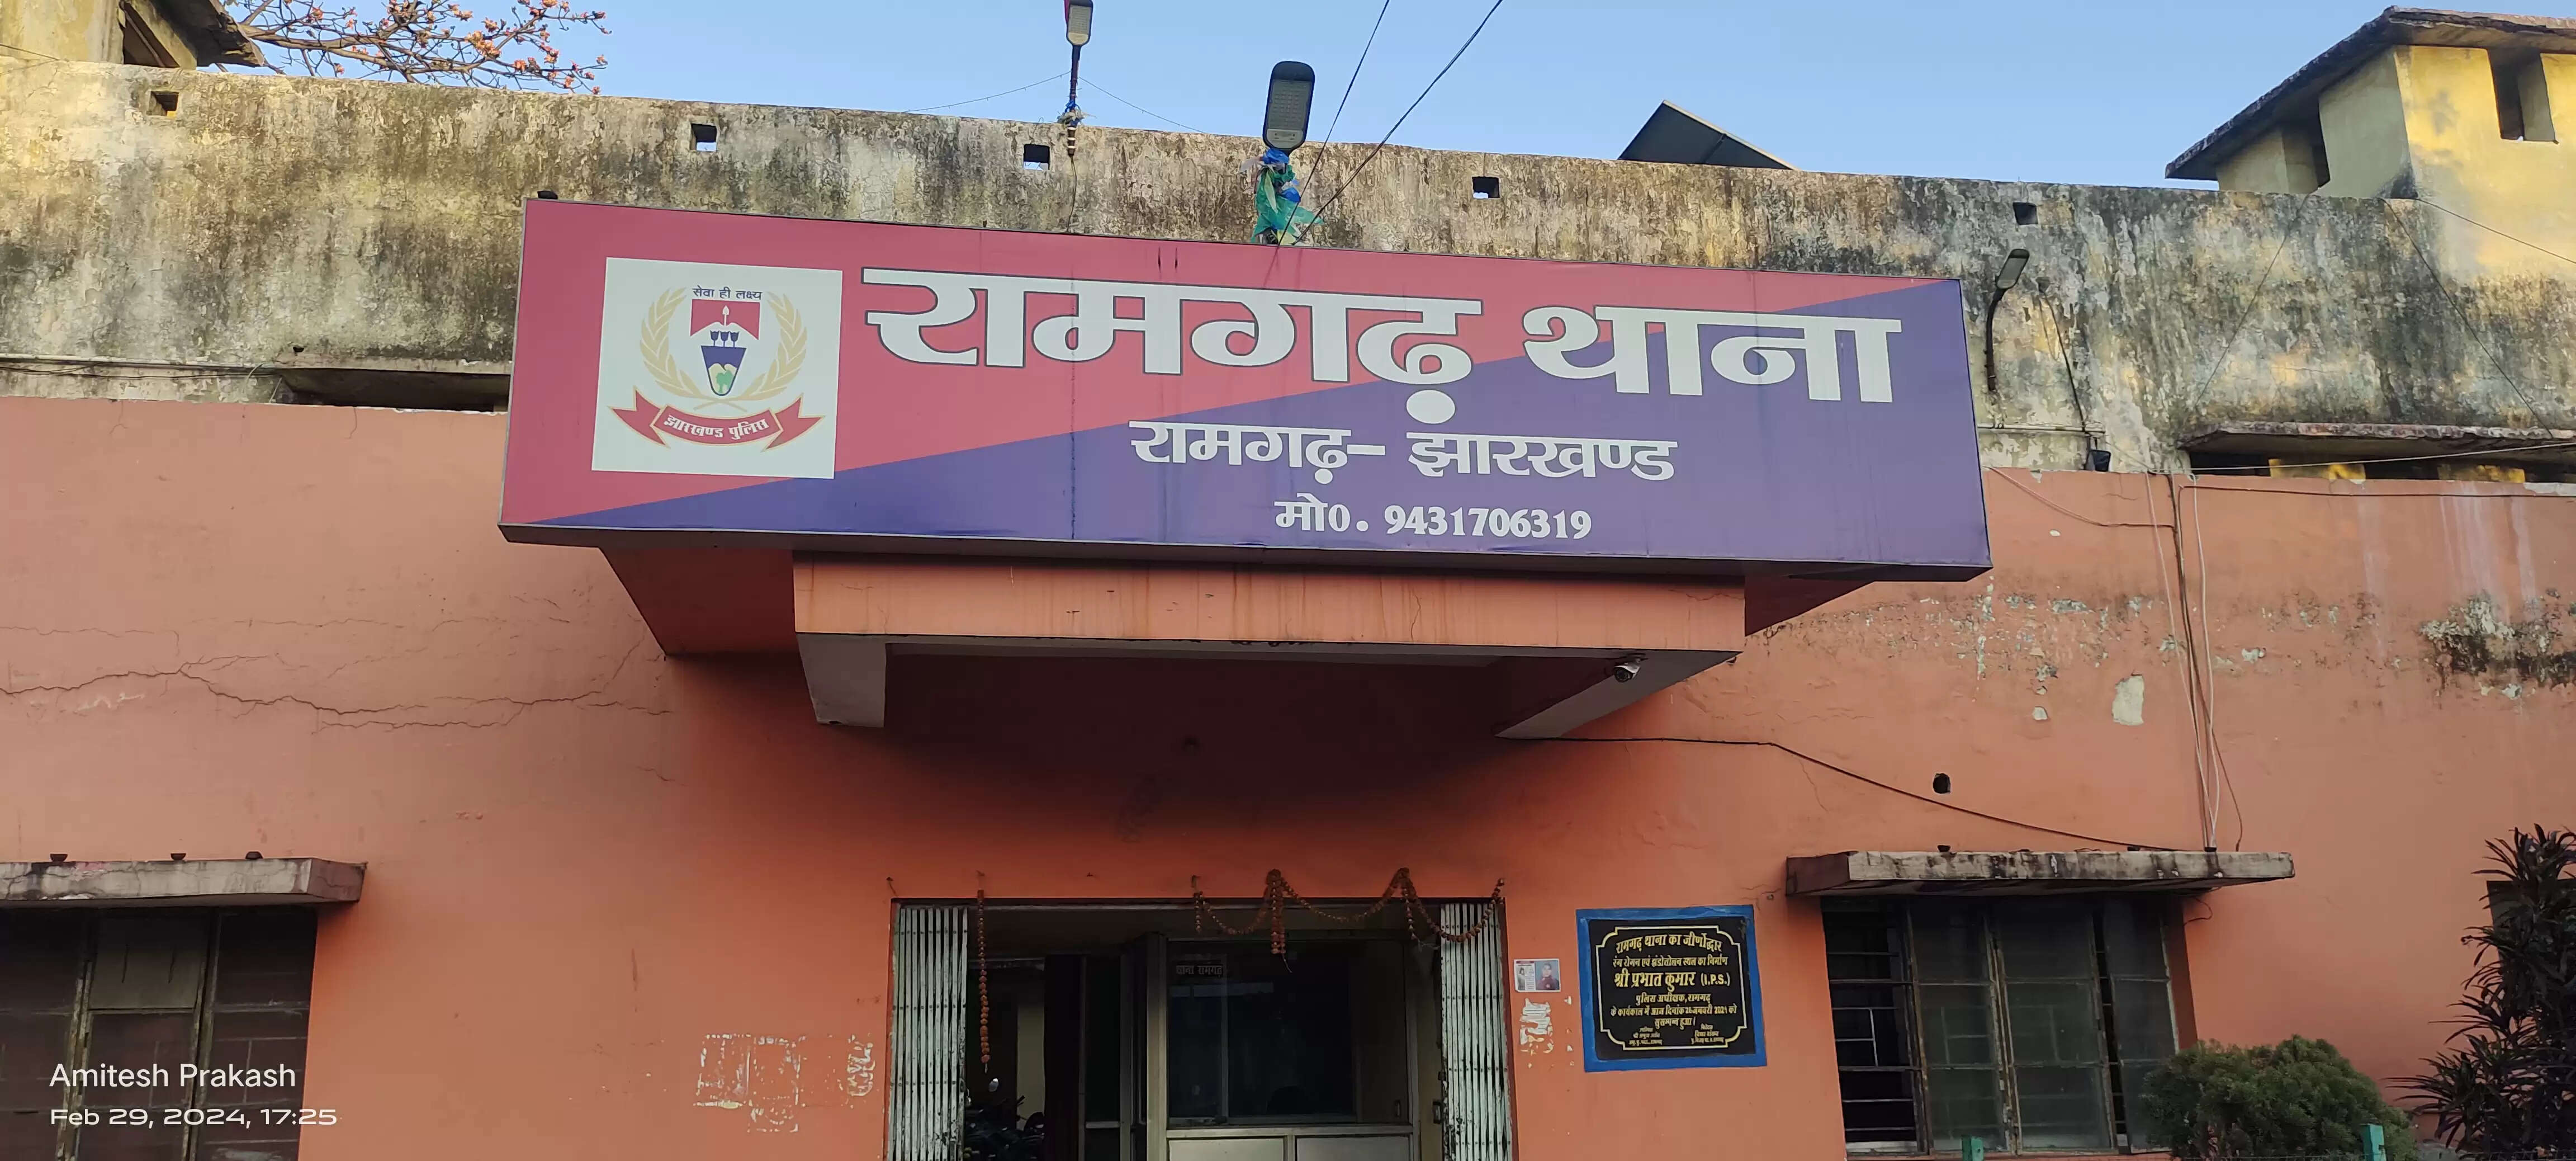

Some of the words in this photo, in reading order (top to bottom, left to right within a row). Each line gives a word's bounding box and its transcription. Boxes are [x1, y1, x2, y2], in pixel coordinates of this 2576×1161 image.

[692, 285, 714, 297] सेवा
[719, 287, 731, 298] ही
[736, 291, 762, 299] लक्ष्य
[864, 269, 1483, 423] रामगढ़
[1524, 306, 1902, 403] थाना
[664, 414, 723, 438] झारखण्ड
[729, 418, 770, 440] पुलिस
[1407, 432, 1678, 480] झारखण्ड
[1385, 506, 1591, 539] 9431706319
[1645, 935, 1667, 946] थाना
[1669, 935, 1682, 945] का
[1613, 956, 1622, 967] रंग
[1624, 956, 1640, 966] रोगन
[1642, 955, 1650, 967] एवं
[1614, 968, 1630, 987] श्री
[1631, 973, 1663, 987] प्रभात
[1665, 972, 1696, 992] कुमार
[1636, 992, 1656, 1006] पुलिस
[1729, 1003, 1737, 1013] को
